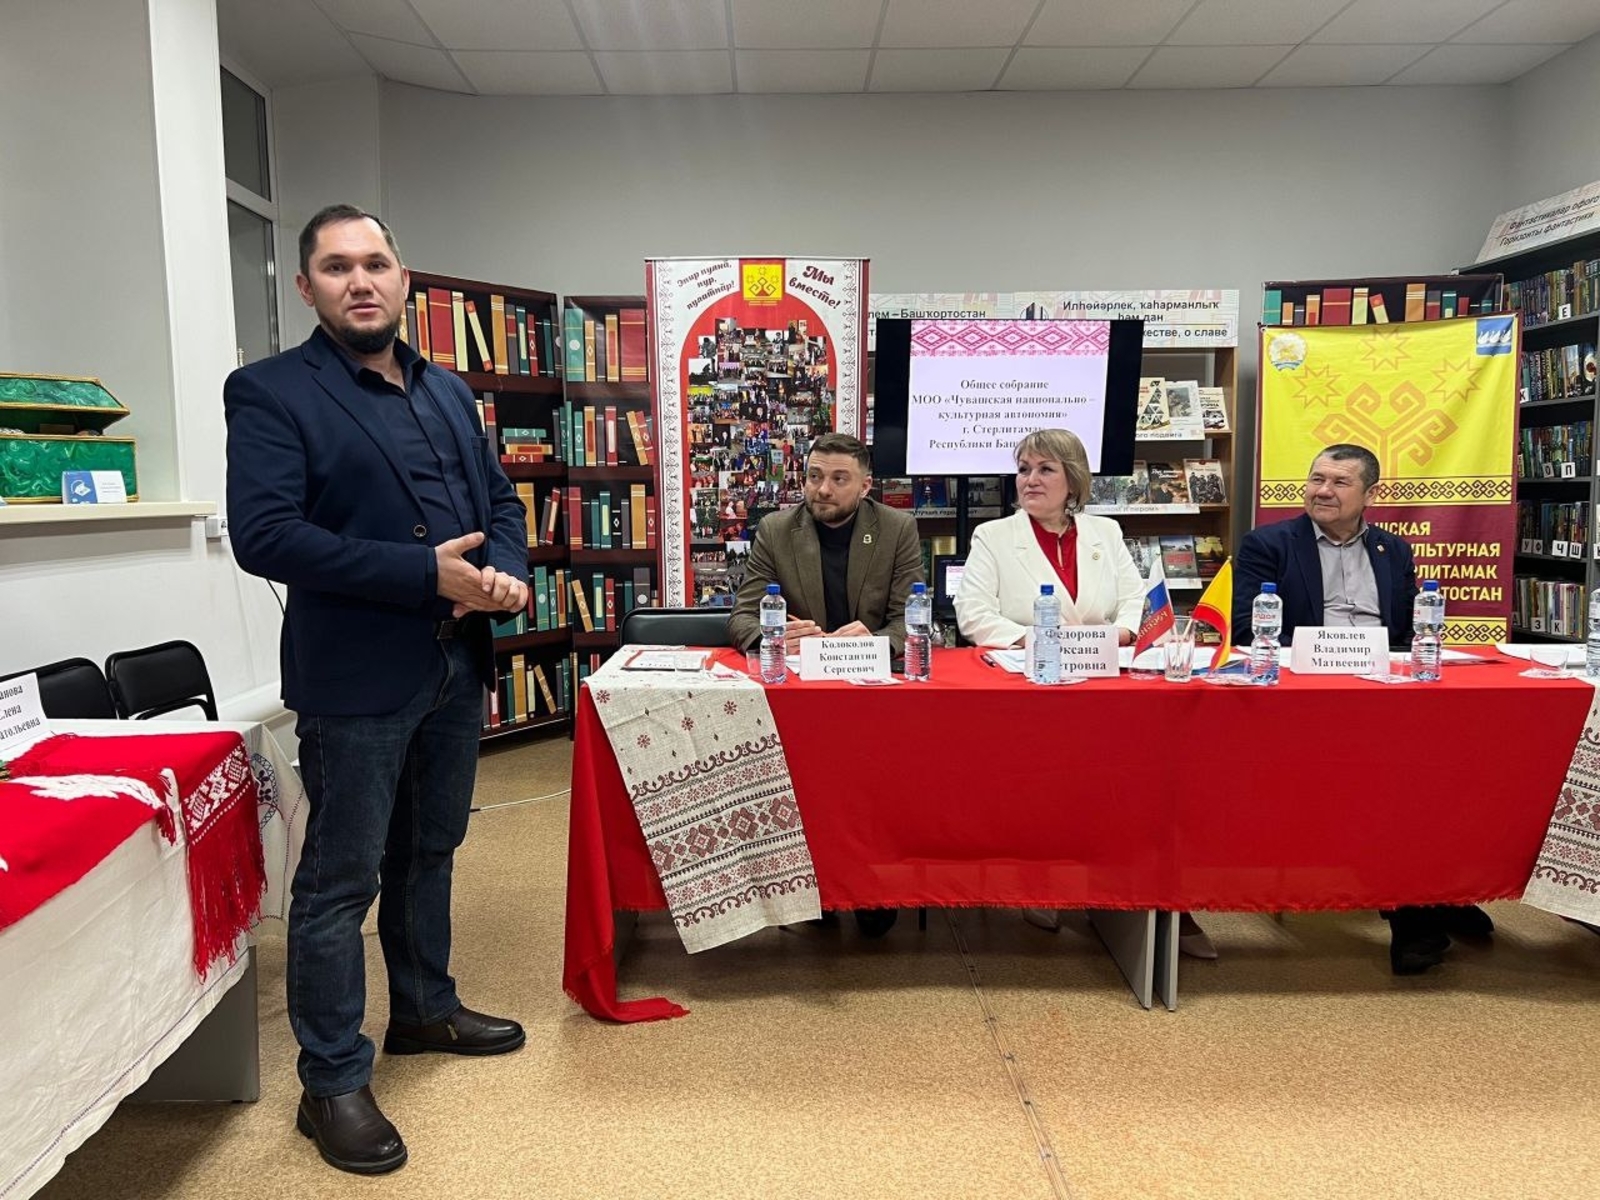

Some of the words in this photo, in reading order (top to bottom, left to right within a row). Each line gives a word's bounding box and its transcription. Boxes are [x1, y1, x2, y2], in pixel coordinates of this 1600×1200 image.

[802, 265, 835, 286] Мы
[789, 277, 841, 310] вместе!
[1184, 330, 1191, 338] о
[1194, 329, 1228, 338] славе
[960, 379, 997, 390] Общее
[1000, 379, 1049, 391] собрание
[912, 395, 942, 405] МОО
[945, 395, 1012, 407] «Чувашская
[1015, 396, 1087, 405] национально
[938, 411, 1001, 422] культурная
[1004, 411, 1068, 420] автономия»
[963, 426, 970, 434] г.
[973, 424, 1041, 436] Стерлитама
[929, 439, 992, 450] Республики
[1565, 464, 1572, 476] П
[1557, 543, 1565, 555] Ч
[1571, 545, 1580, 556] Ш
[1420, 587, 1503, 601] ТОСТАН
[1554, 622, 1561, 633] К
[1317, 630, 1366, 640] Яковлев
[821, 640, 874, 649] Колоколов
[1314, 644, 1371, 656] Владимир
[819, 653, 877, 662] Константин
[823, 665, 875, 676] Сергеевич
[1060, 662, 1106, 673] тровна
